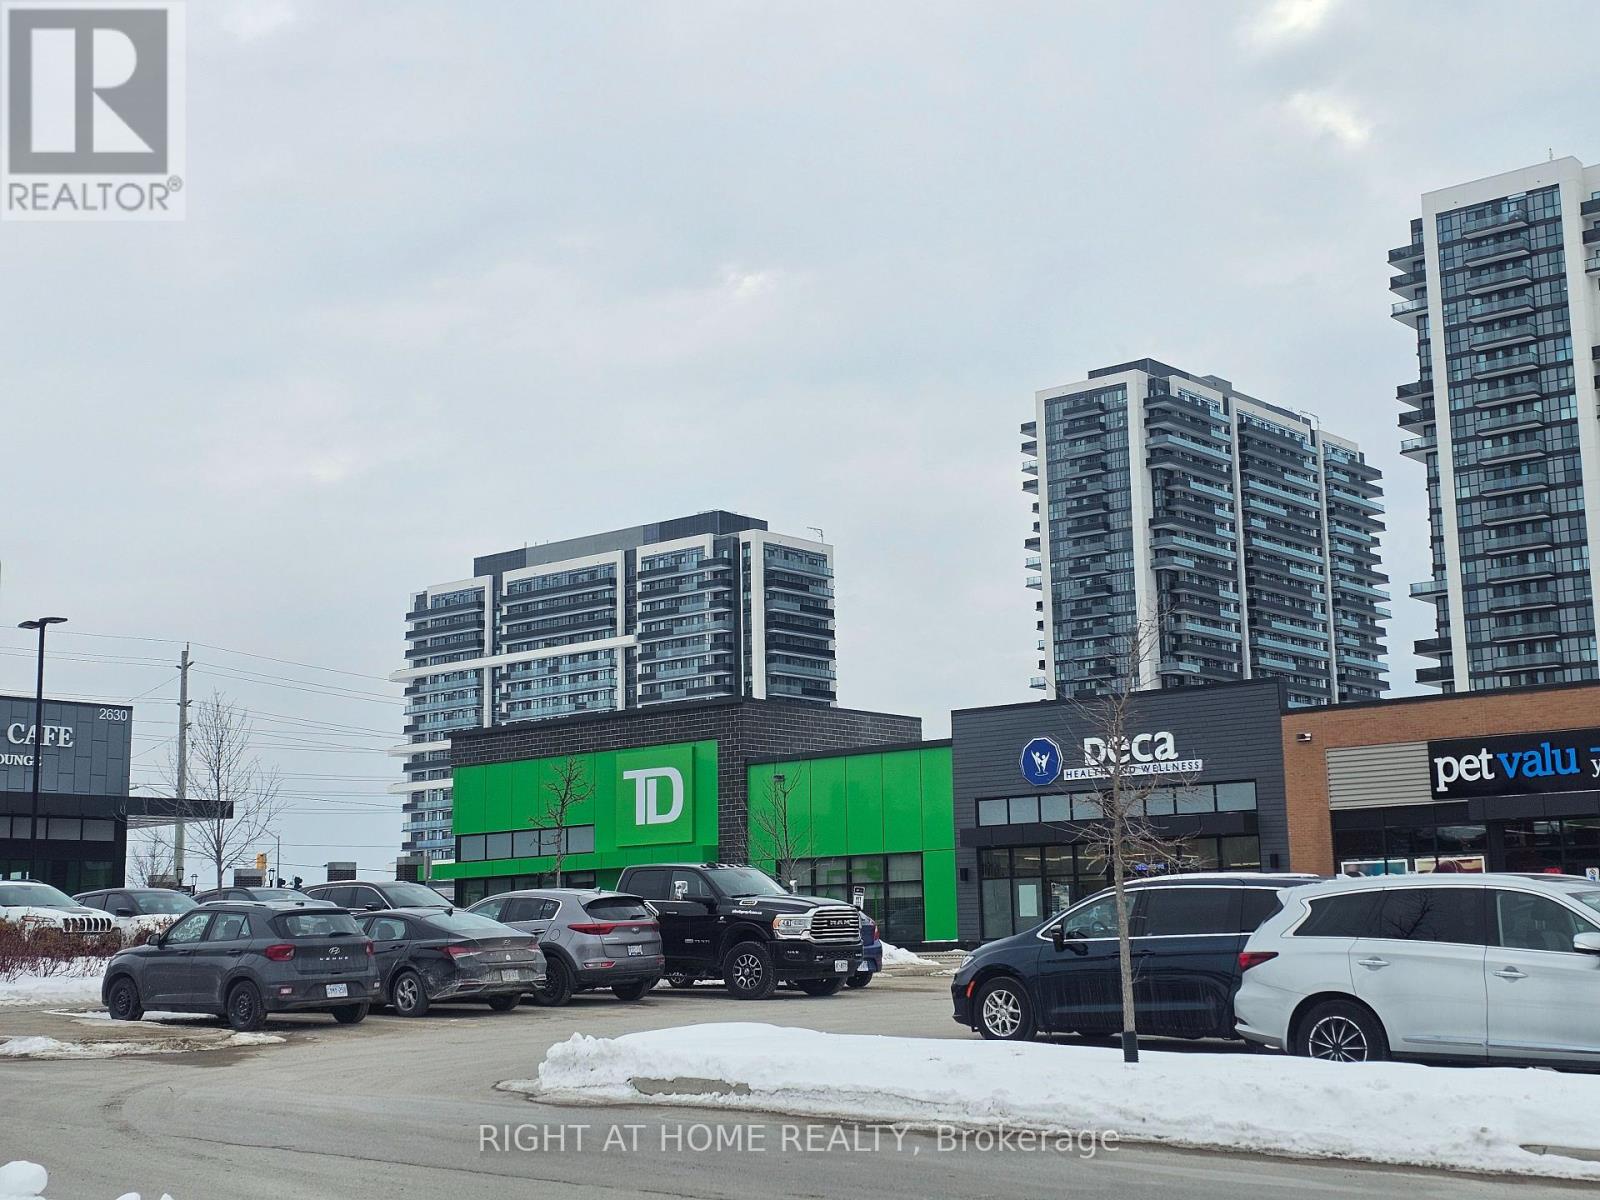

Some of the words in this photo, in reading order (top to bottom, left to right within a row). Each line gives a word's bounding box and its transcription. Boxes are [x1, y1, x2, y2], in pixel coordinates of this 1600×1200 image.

[98, 708, 128, 722] 2630
[7, 723, 74, 748] CAFE
[1083, 731, 1179, 765] Deca
[1141, 760, 1200, 773] WELLNESS
[1434, 747, 1495, 792] pet
[1496, 741, 1581, 779] valu
[623, 766, 684, 826] TD
